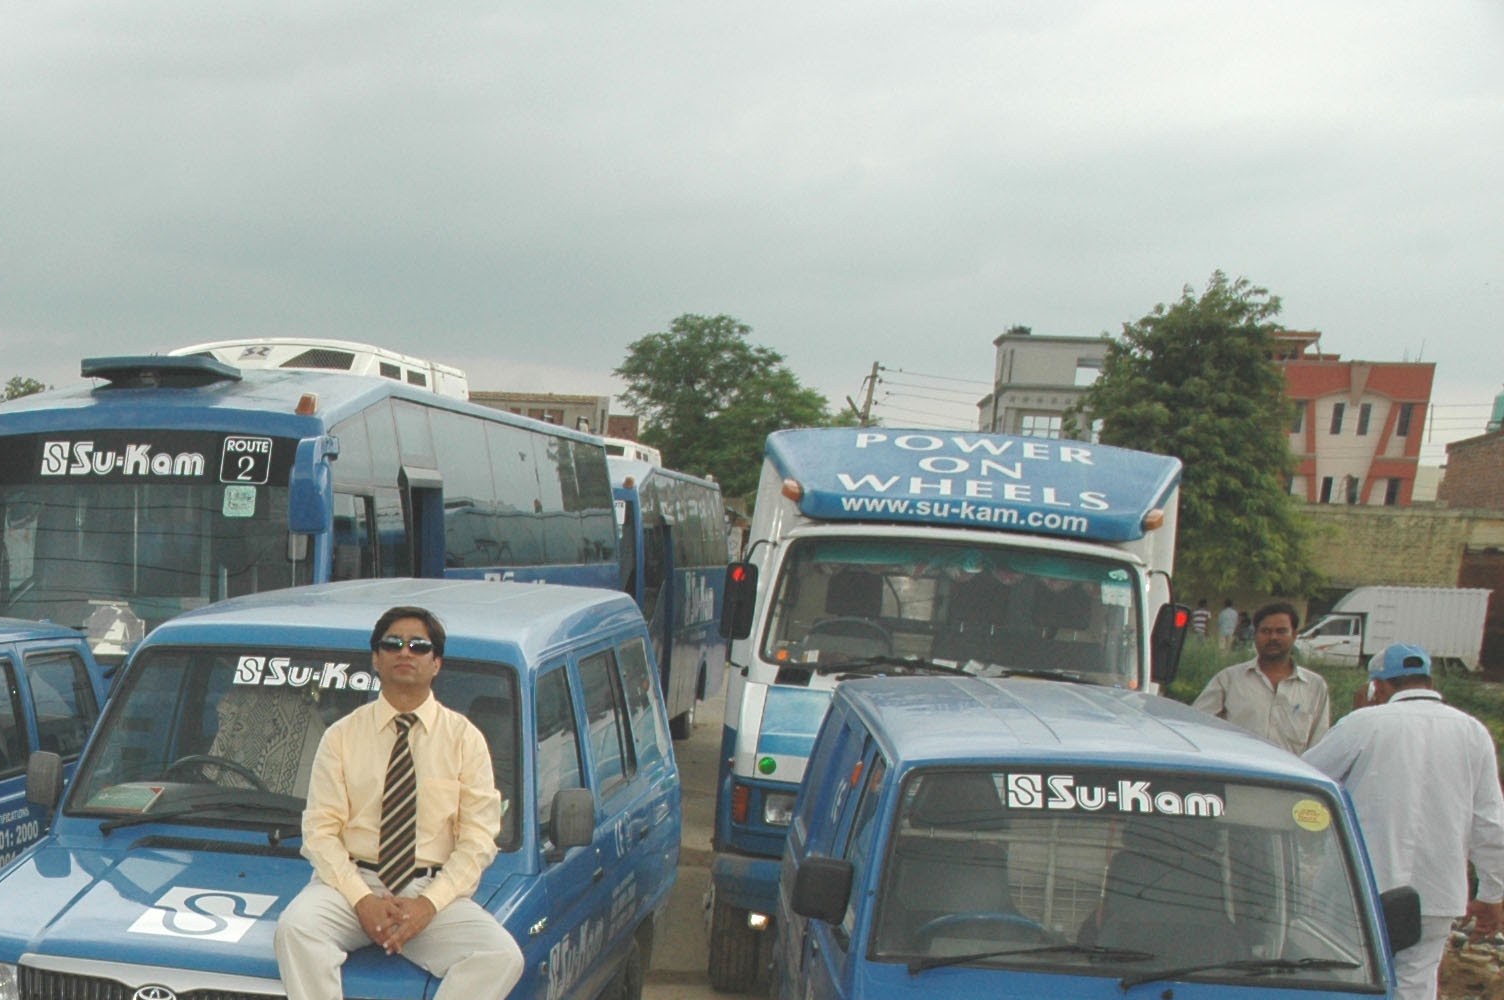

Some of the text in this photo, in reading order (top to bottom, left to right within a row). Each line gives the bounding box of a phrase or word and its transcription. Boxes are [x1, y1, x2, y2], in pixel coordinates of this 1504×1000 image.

[70, 441, 205, 476] Su-Kam
[227, 440, 269, 453] ROUTE
[856, 433, 1094, 465] POWER
[237, 456, 256, 480] 2
[918, 456, 1022, 479] ON
[836, 473, 1109, 511] WHEELS
[841, 497, 1088, 533] www.su-kam.com
[264, 657, 381, 691] Su-Ka
[1047, 775, 1225, 817] Su-Kam
[16, 820, 39, 844] 2000
